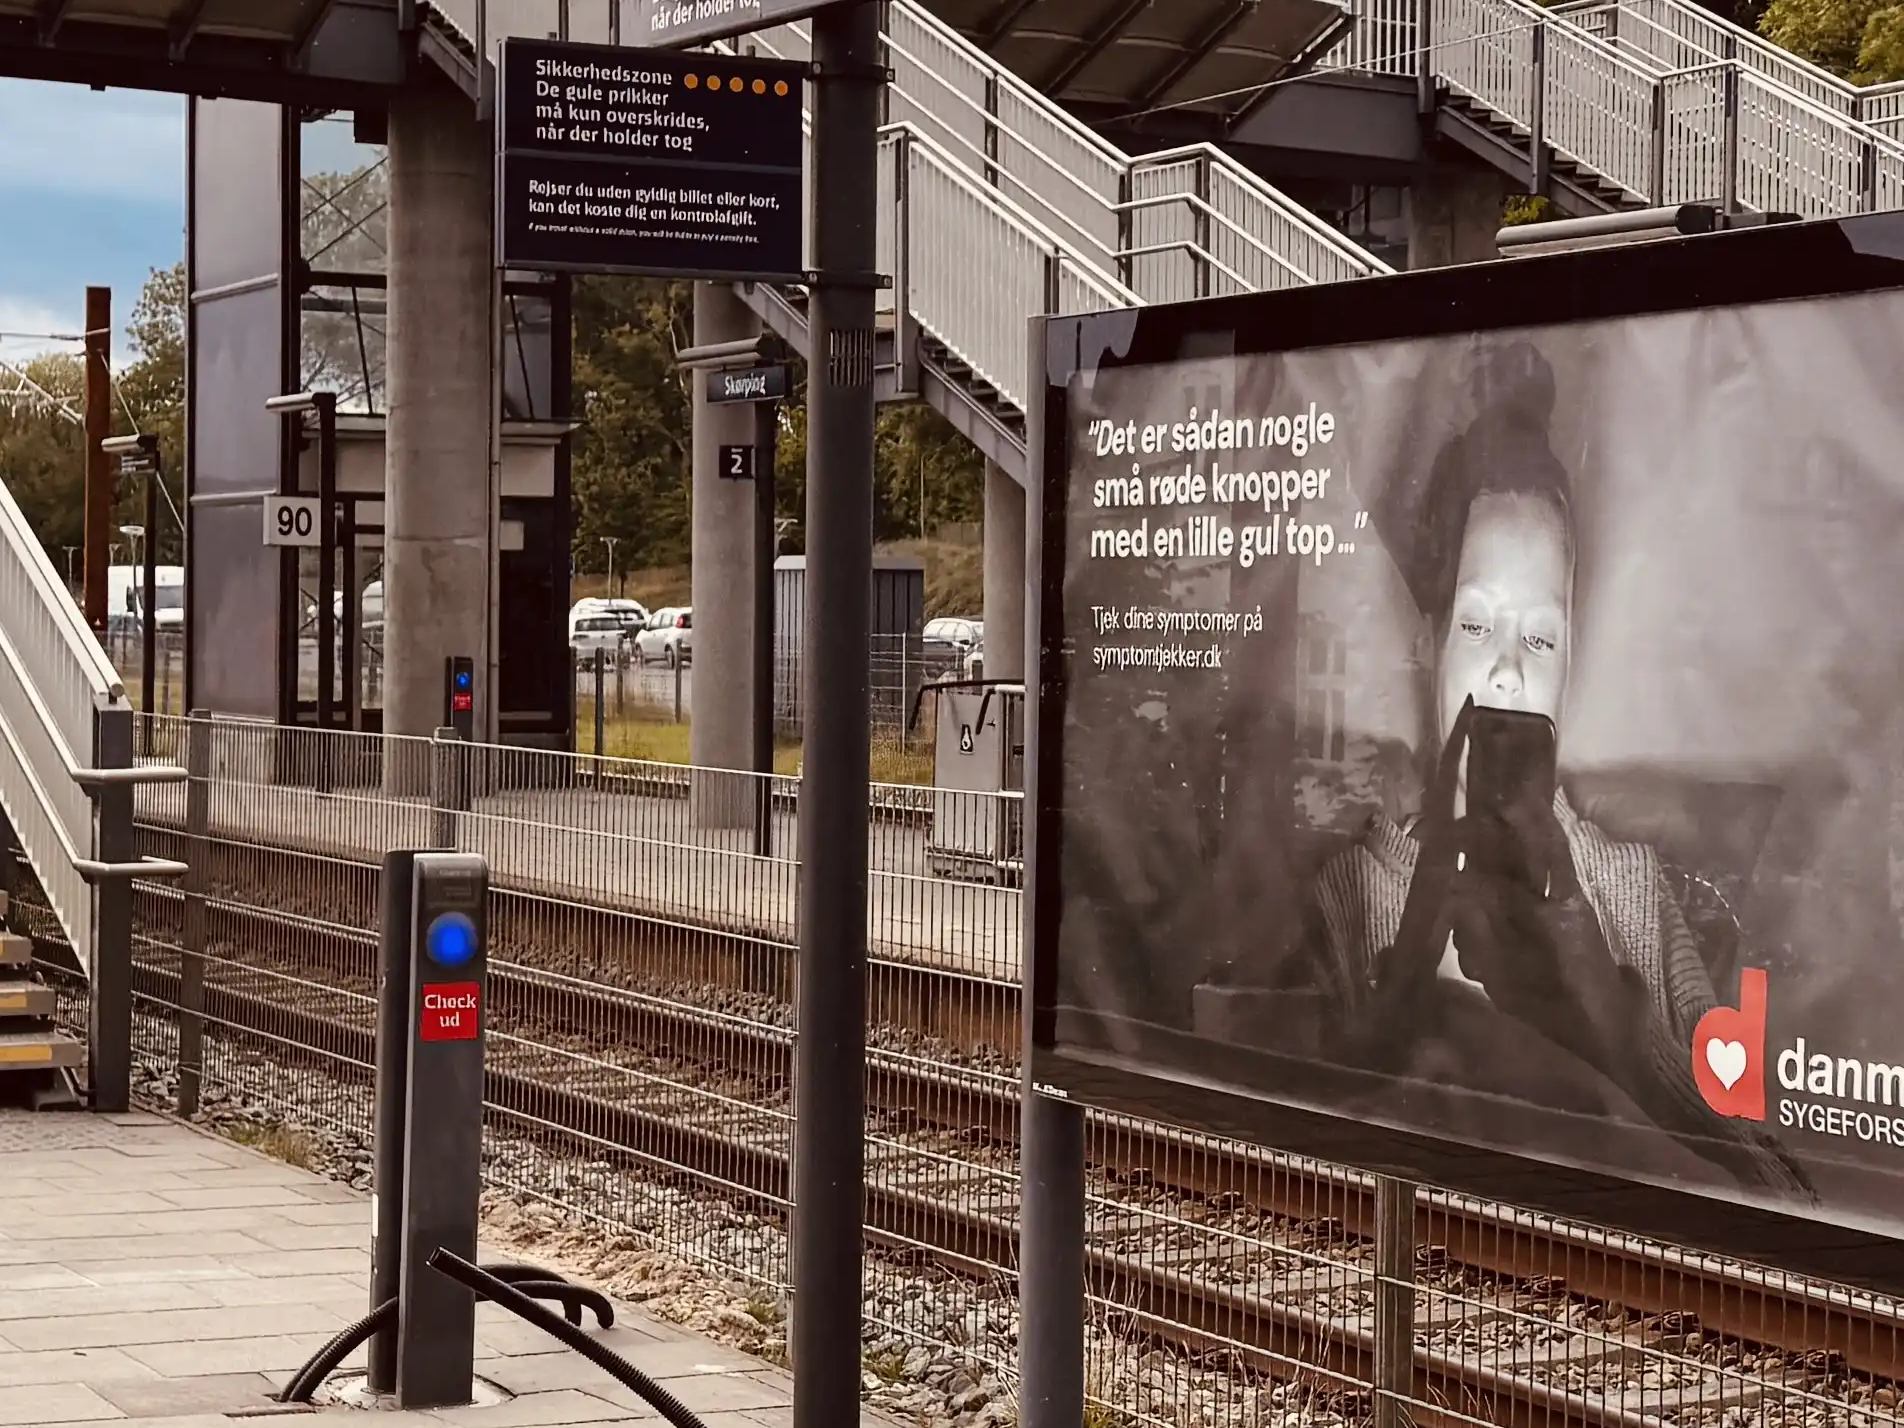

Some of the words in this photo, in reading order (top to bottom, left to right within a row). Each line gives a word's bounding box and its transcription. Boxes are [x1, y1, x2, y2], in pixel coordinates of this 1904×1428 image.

[651, 5, 671, 31] når
[673, 1, 692, 26] der
[536, 59, 672, 86] Sikkerhedszone
[536, 80, 560, 98] De
[566, 84, 603, 102] gule
[608, 87, 669, 106] prikker
[536, 102, 563, 119] må
[569, 104, 601, 121] kun
[606, 109, 710, 132] overskrides,
[536, 122, 566, 140] når
[569, 124, 598, 142] der
[603, 127, 659, 147] holder
[664, 134, 693, 152] tog
[529, 199, 555, 213] kan
[558, 200, 581, 216] det
[625, 204, 647, 221] dig
[650, 209, 667, 221] en
[575, 181, 593, 197] du
[597, 185, 631, 200] uden
[749, 192, 780, 210] kort,
[1141, 424, 1167, 453] er
[1171, 407, 1253, 452] sådan
[1259, 402, 1335, 457] nogle
[730, 454, 743, 474] 2
[1094, 462, 1144, 507] små
[1149, 463, 1206, 506] røde
[1212, 462, 1331, 512] knopper
[277, 505, 313, 537] 90
[1090, 518, 1147, 558] med
[1154, 525, 1183, 556] en
[1188, 516, 1234, 556] lille
[1239, 514, 1280, 568] gul
[1090, 605, 1120, 635] Tjek
[1124, 605, 1154, 629] dine
[1157, 609, 1241, 637] symptomer
[1243, 605, 1263, 637] på
[1092, 643, 1222, 673] symptomtjekker.dk
[424, 993, 477, 1009] Check
[439, 1013, 461, 1028] ud
